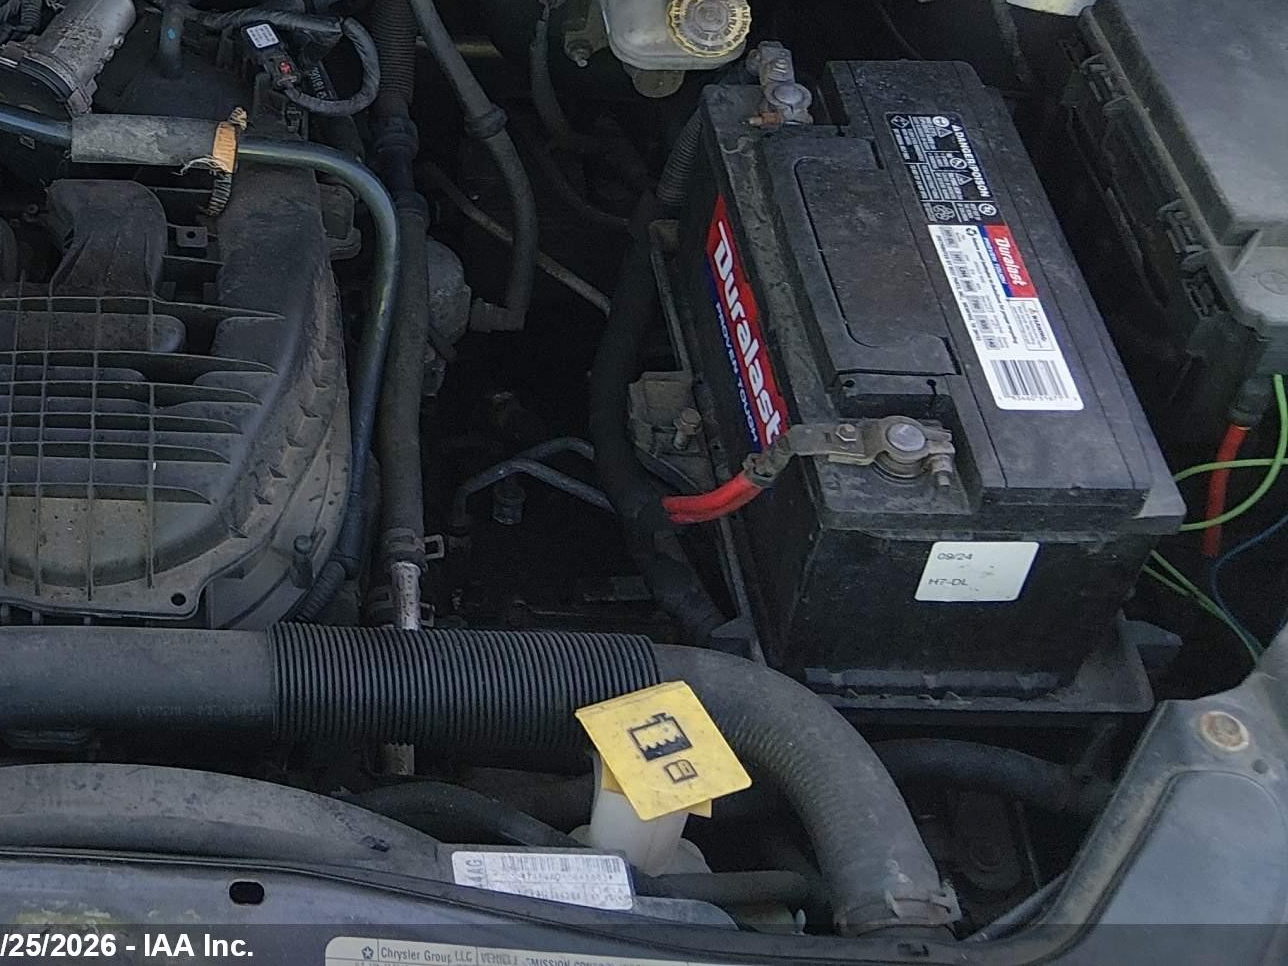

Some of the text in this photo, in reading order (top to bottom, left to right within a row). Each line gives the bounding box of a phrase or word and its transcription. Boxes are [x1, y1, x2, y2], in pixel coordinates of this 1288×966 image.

[994, 236, 1028, 287] Duralast
[713, 220, 782, 445] Duralast
[715, 301, 759, 444] PROVEN TOUGH
[937, 552, 973, 561] 09/24
[928, 578, 969, 587] H7-DL
[380, 946, 421, 961] Chrysler
[455, 949, 473, 963] LLC
